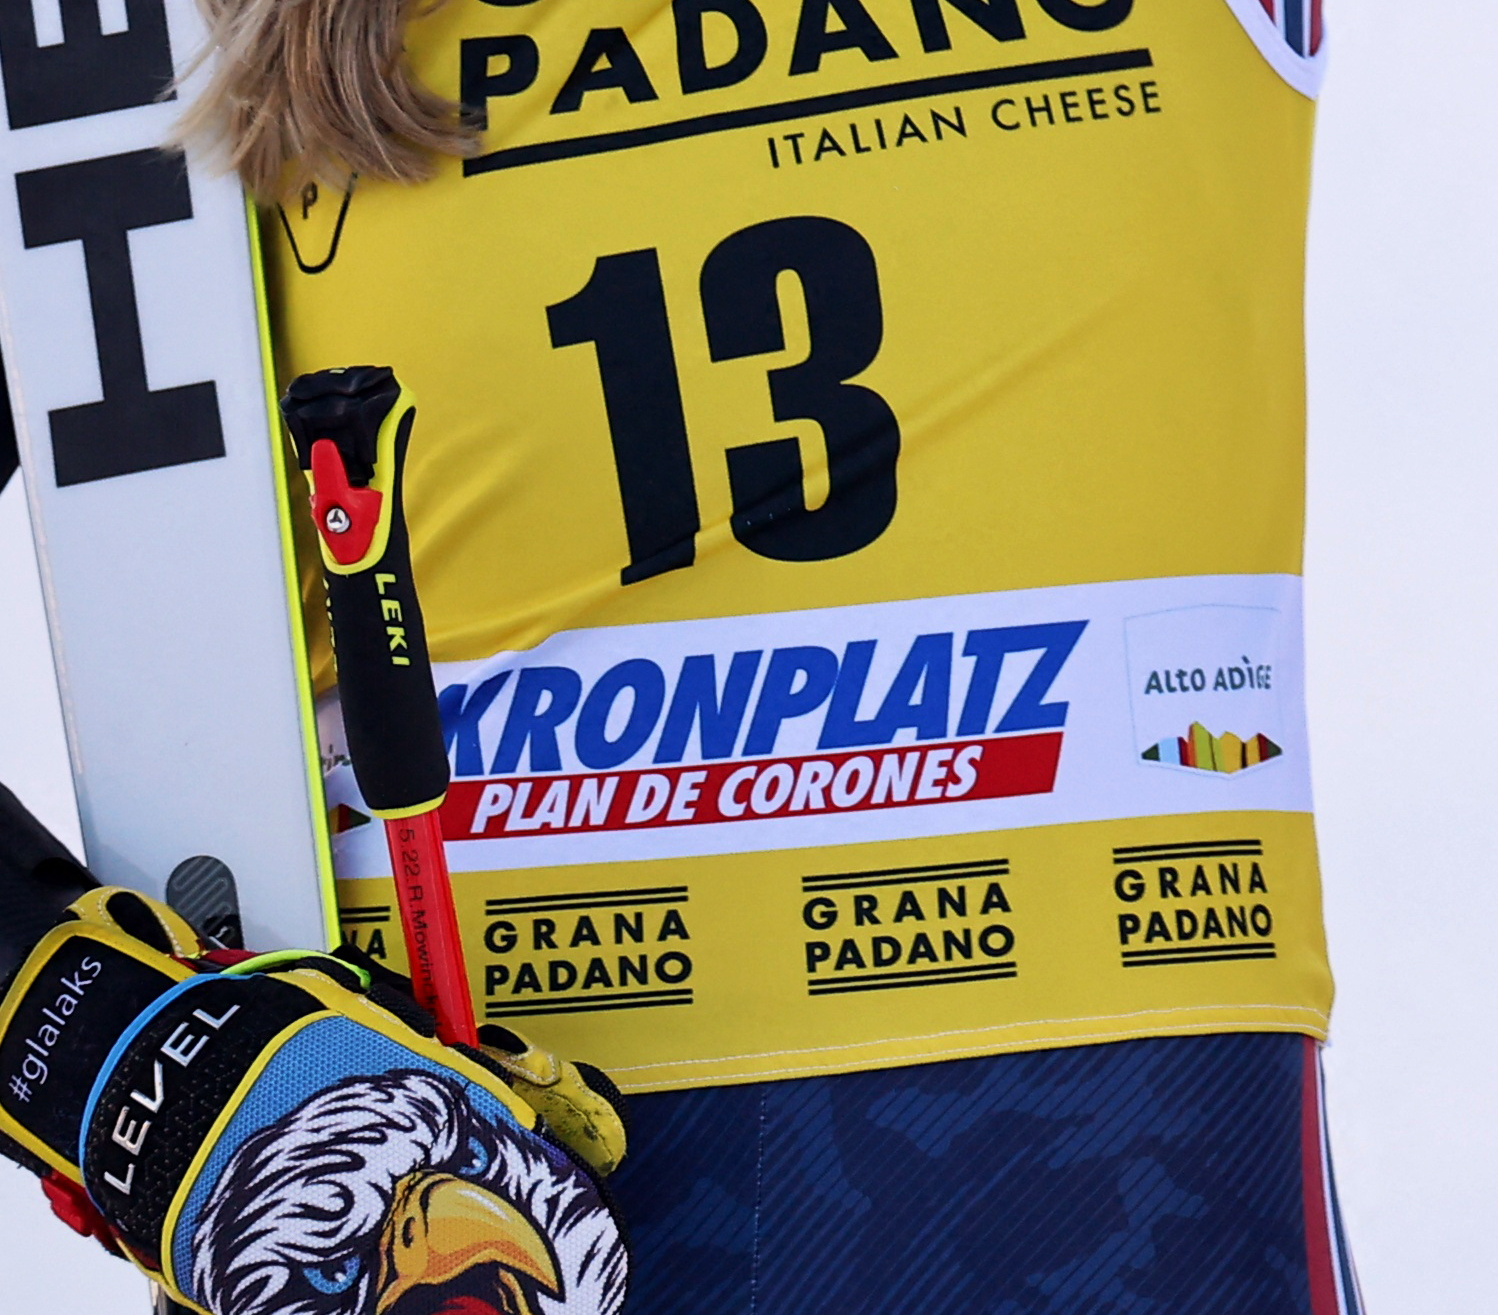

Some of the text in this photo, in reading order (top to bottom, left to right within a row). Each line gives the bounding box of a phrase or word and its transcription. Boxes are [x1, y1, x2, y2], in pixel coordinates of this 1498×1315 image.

[766, 80, 1163, 170] ITALIAN CHEESE
[546, 215, 902, 587] 13
[373, 573, 411, 666] LEKI
[437, 619, 1090, 777] KRONPLATZ
[469, 745, 985, 835] PLAN DE CORONES
[802, 882, 1012, 930] GRANA
[1112, 861, 1270, 903] GRANA
[1117, 904, 1274, 947] PADANO
[483, 910, 691, 955] GRANA
[484, 951, 693, 998] PADANO
[804, 925, 1017, 974] PADANO
[9, 953, 104, 1106] #glalaks
[103, 996, 241, 1197] LEVEL
